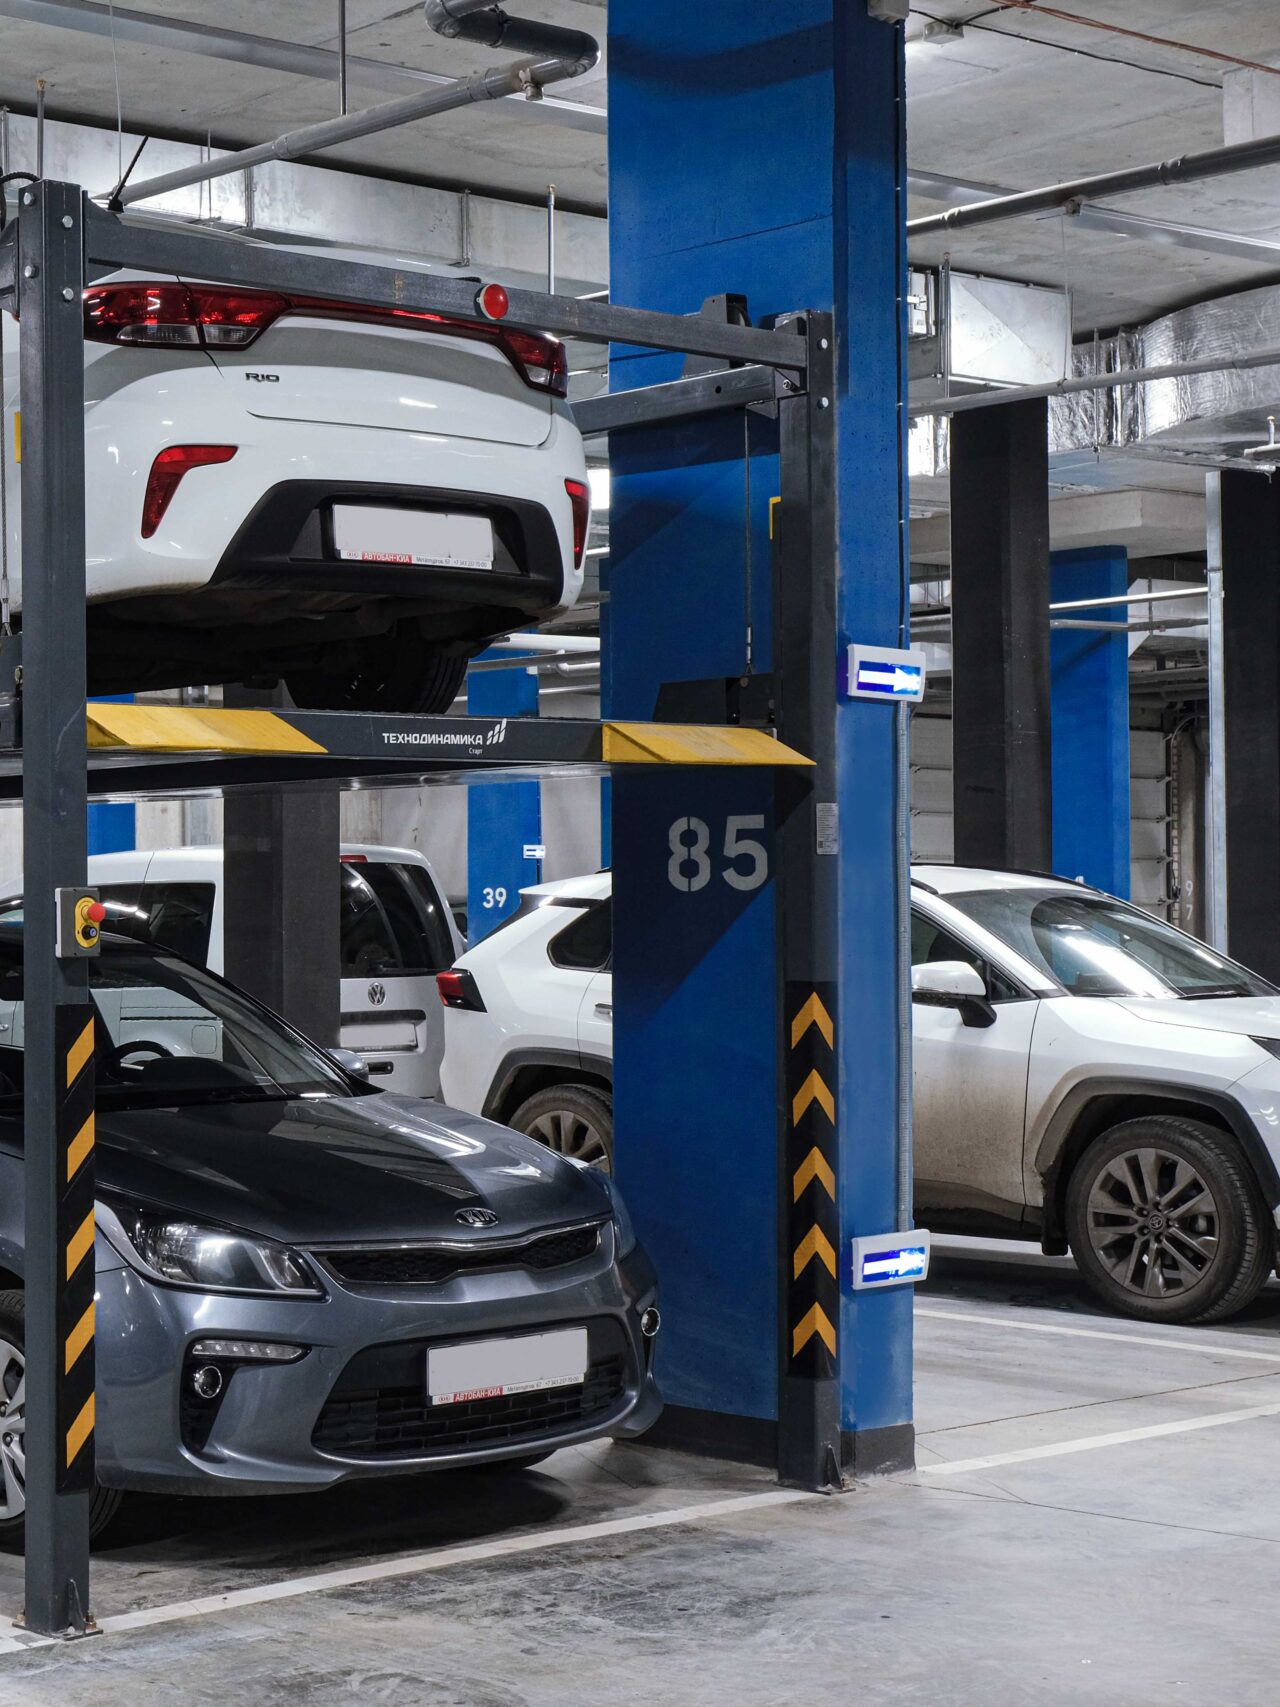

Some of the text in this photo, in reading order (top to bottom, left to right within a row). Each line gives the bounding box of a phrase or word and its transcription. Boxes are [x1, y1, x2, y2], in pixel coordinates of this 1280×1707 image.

[245, 372, 280, 382] RIO
[364, 552, 410, 563] АВТОБАН-КИА
[382, 732, 483, 745] ТЕХНОДИНАМИКА
[667, 814, 769, 892] 85
[482, 887, 507, 909] 39
[454, 1388, 501, 1401] АВТОБАН-КИА
